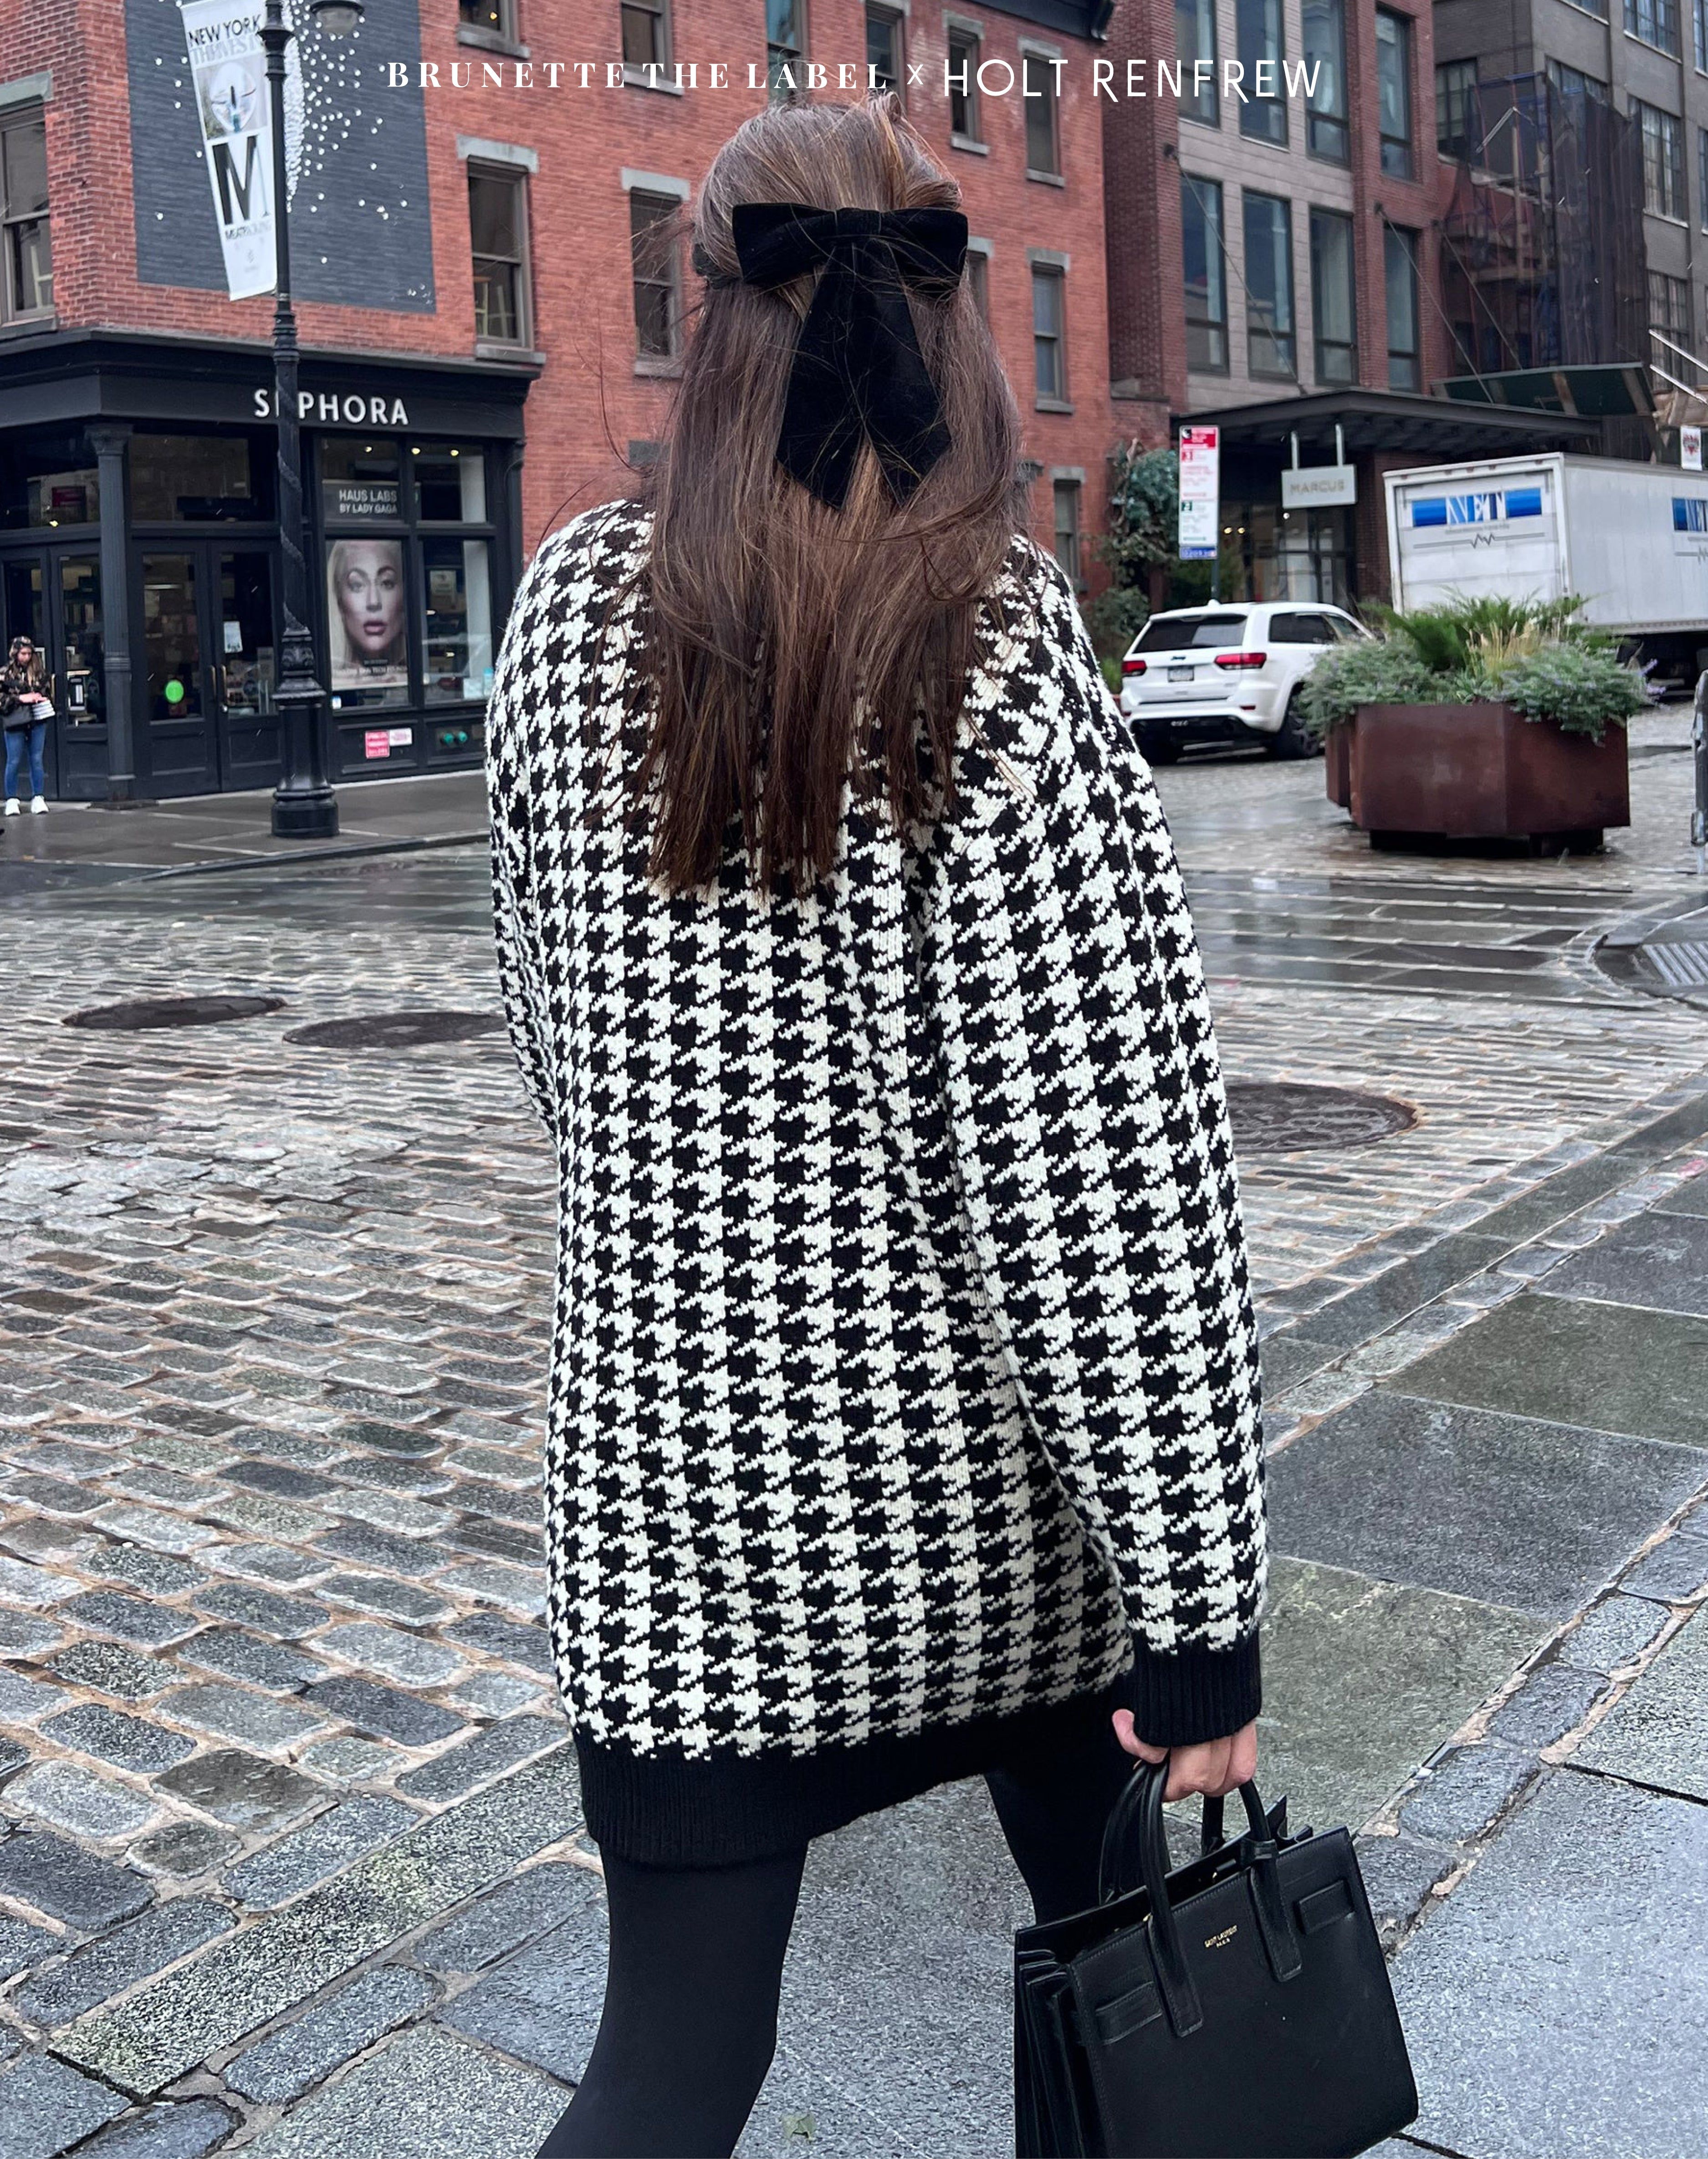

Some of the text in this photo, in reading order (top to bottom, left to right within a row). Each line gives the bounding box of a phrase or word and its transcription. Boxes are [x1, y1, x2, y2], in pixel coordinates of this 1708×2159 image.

[188, 14, 261, 48] NEW YORK
[212, 134, 270, 225] M
[254, 389, 409, 425] SPHORA
[339, 489, 397, 503] HAUS LABS
[1290, 479, 1345, 495] MARCUS
[340, 503, 351, 513] BY
[353, 504, 373, 513] LADY
[1447, 492, 1502, 524] NET
